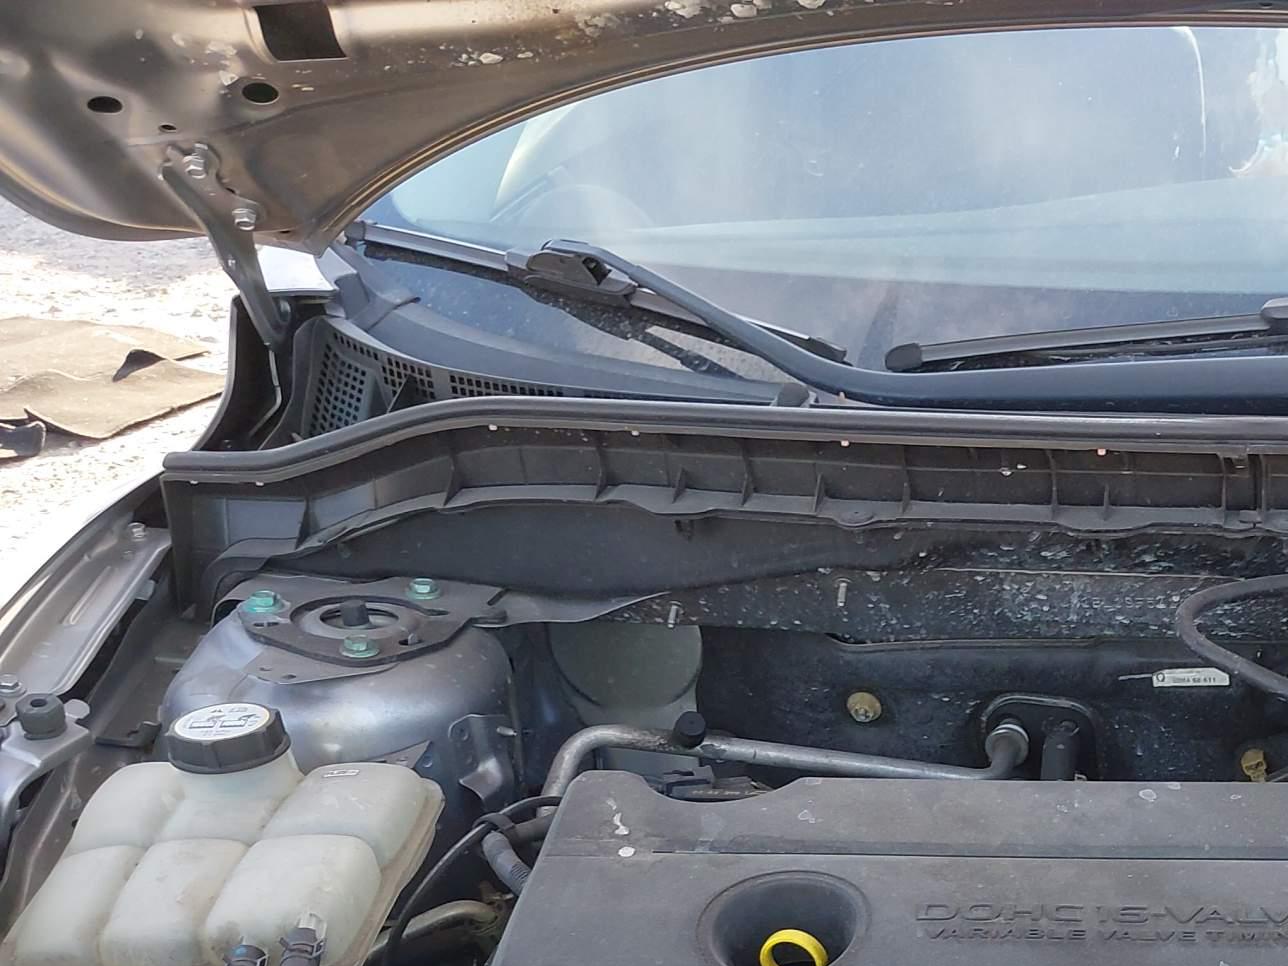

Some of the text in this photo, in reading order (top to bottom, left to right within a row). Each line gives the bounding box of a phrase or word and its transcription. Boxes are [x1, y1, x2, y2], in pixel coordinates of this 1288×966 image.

[915, 903, 1085, 922] DOHC
[925, 928, 1087, 942] VARIABLE
[1101, 928, 1198, 942] VALVE
